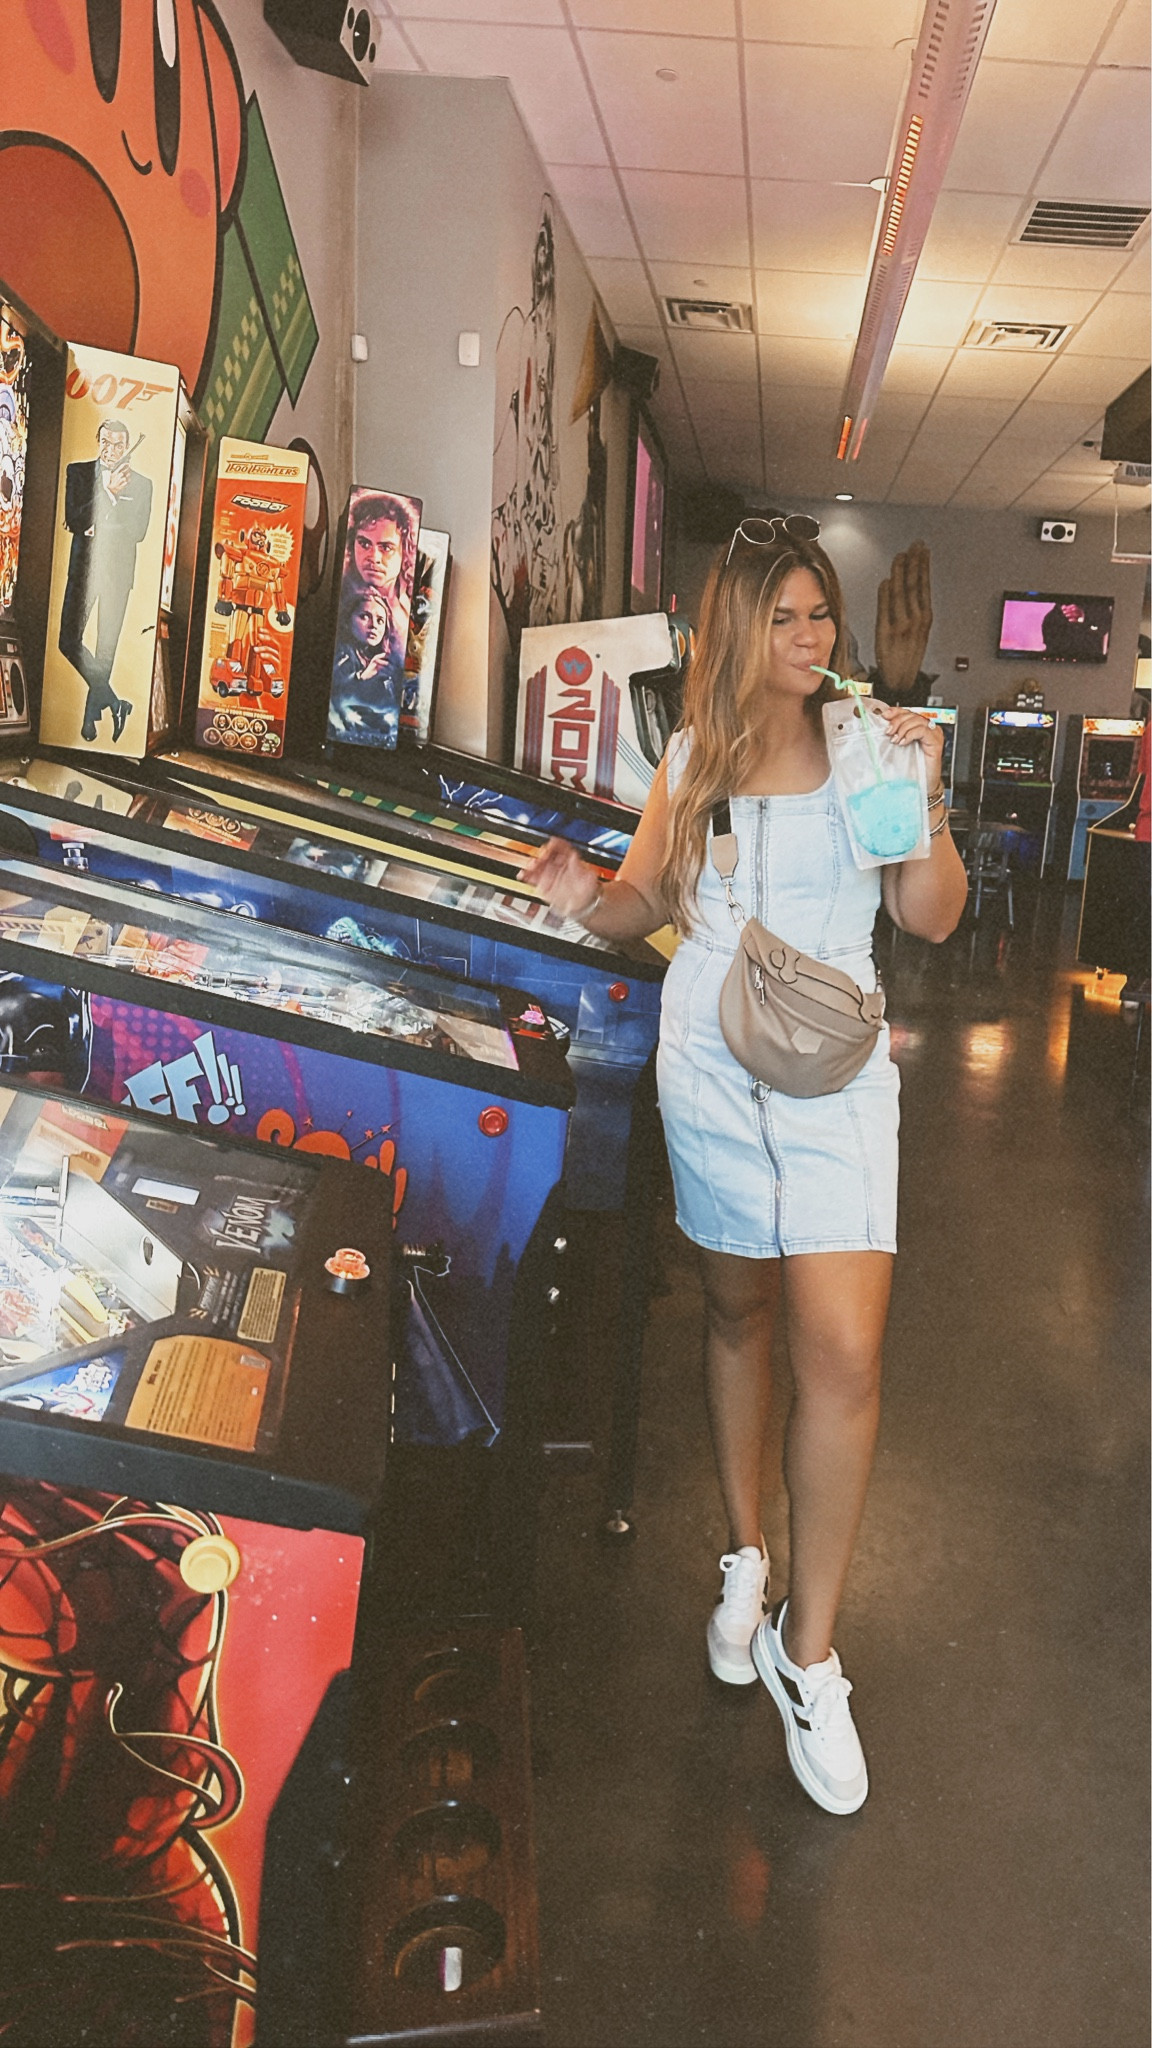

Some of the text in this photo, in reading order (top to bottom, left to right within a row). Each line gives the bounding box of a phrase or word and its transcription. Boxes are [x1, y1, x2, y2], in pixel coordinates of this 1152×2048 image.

[66, 368, 145, 409] 007
[225, 462, 300, 477] FOO FIGHTERS
[210, 1194, 280, 1253] VENOM
